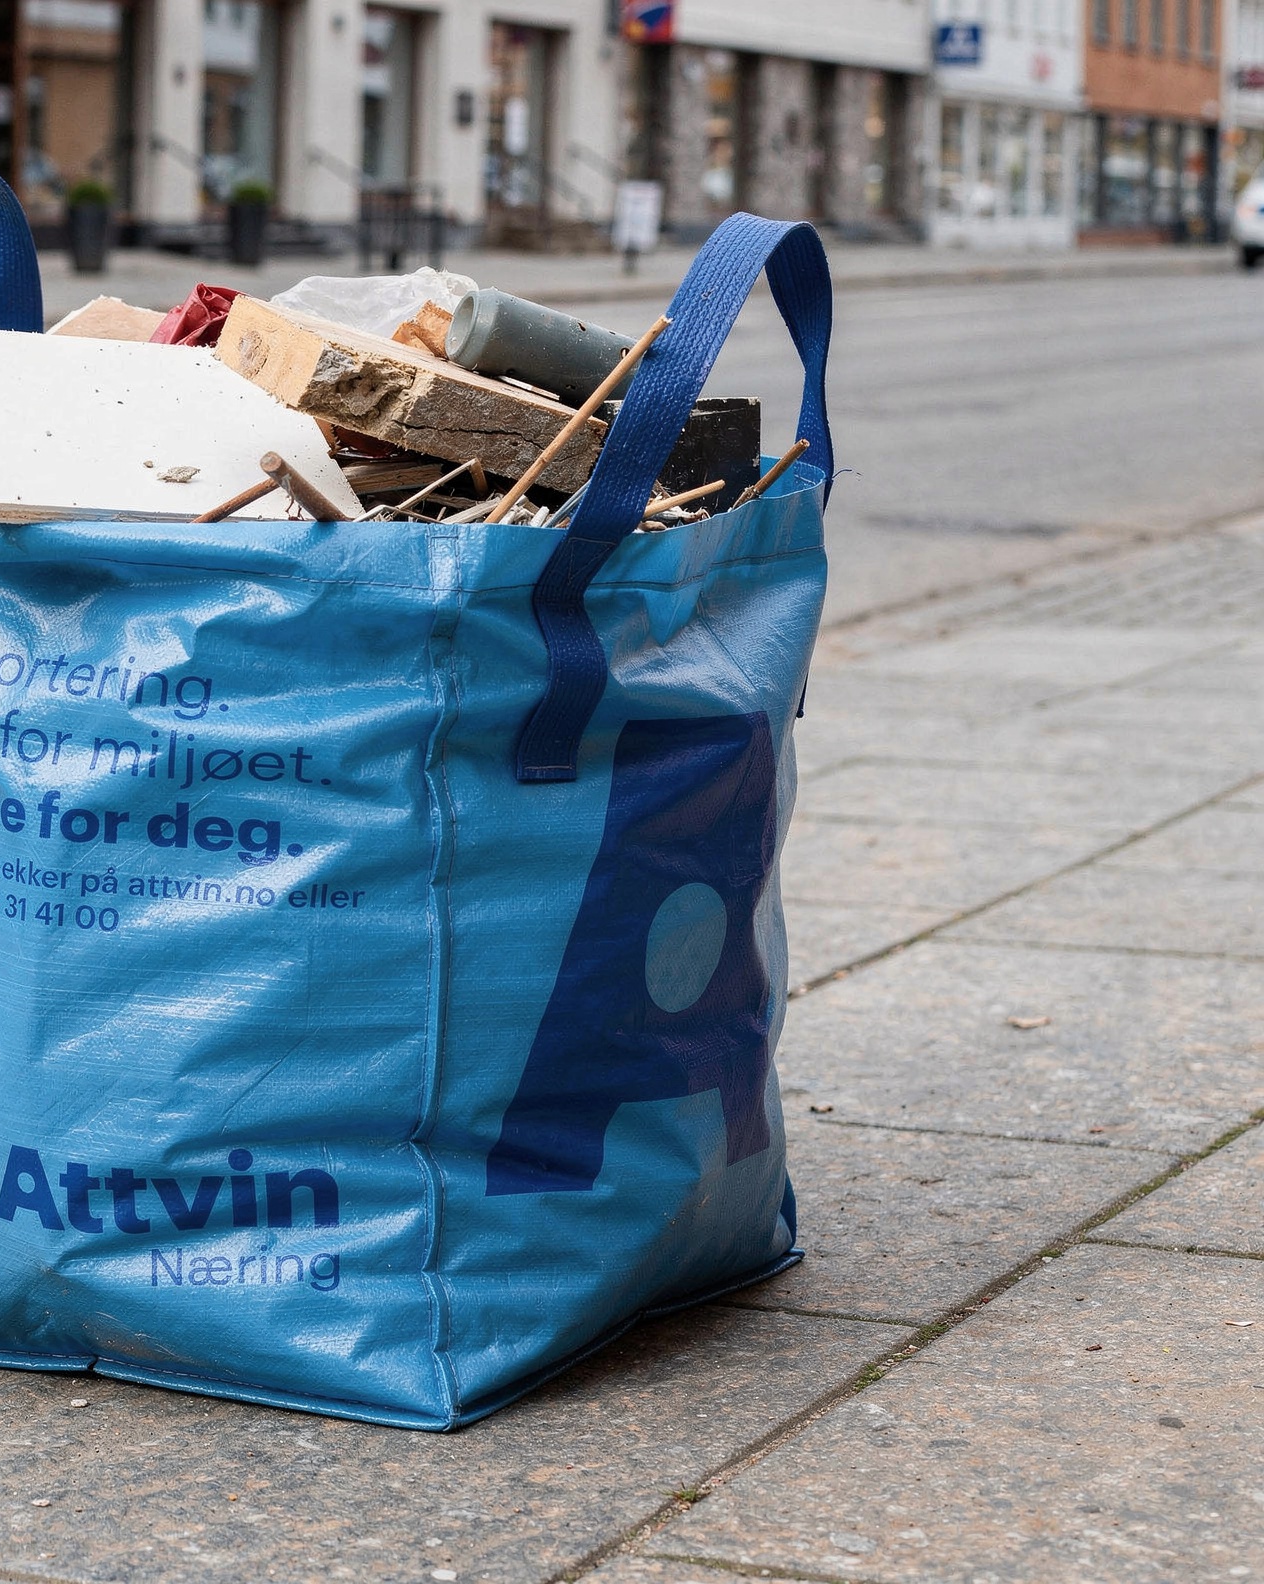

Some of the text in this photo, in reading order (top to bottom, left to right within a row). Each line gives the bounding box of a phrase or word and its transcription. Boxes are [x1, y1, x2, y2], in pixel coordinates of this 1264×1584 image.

[0, 708, 74, 766] for
[89, 729, 332, 790] miljøet.
[37, 790, 130, 844] for
[147, 802, 304, 866] deg.
[80, 866, 119, 898] på
[128, 874, 276, 907] attvin.no
[287, 883, 366, 909] eller
[4, 894, 27, 921] 31
[35, 901, 66, 927] 41
[74, 903, 120, 932] 00
[150, 1245, 340, 1292] Næring
